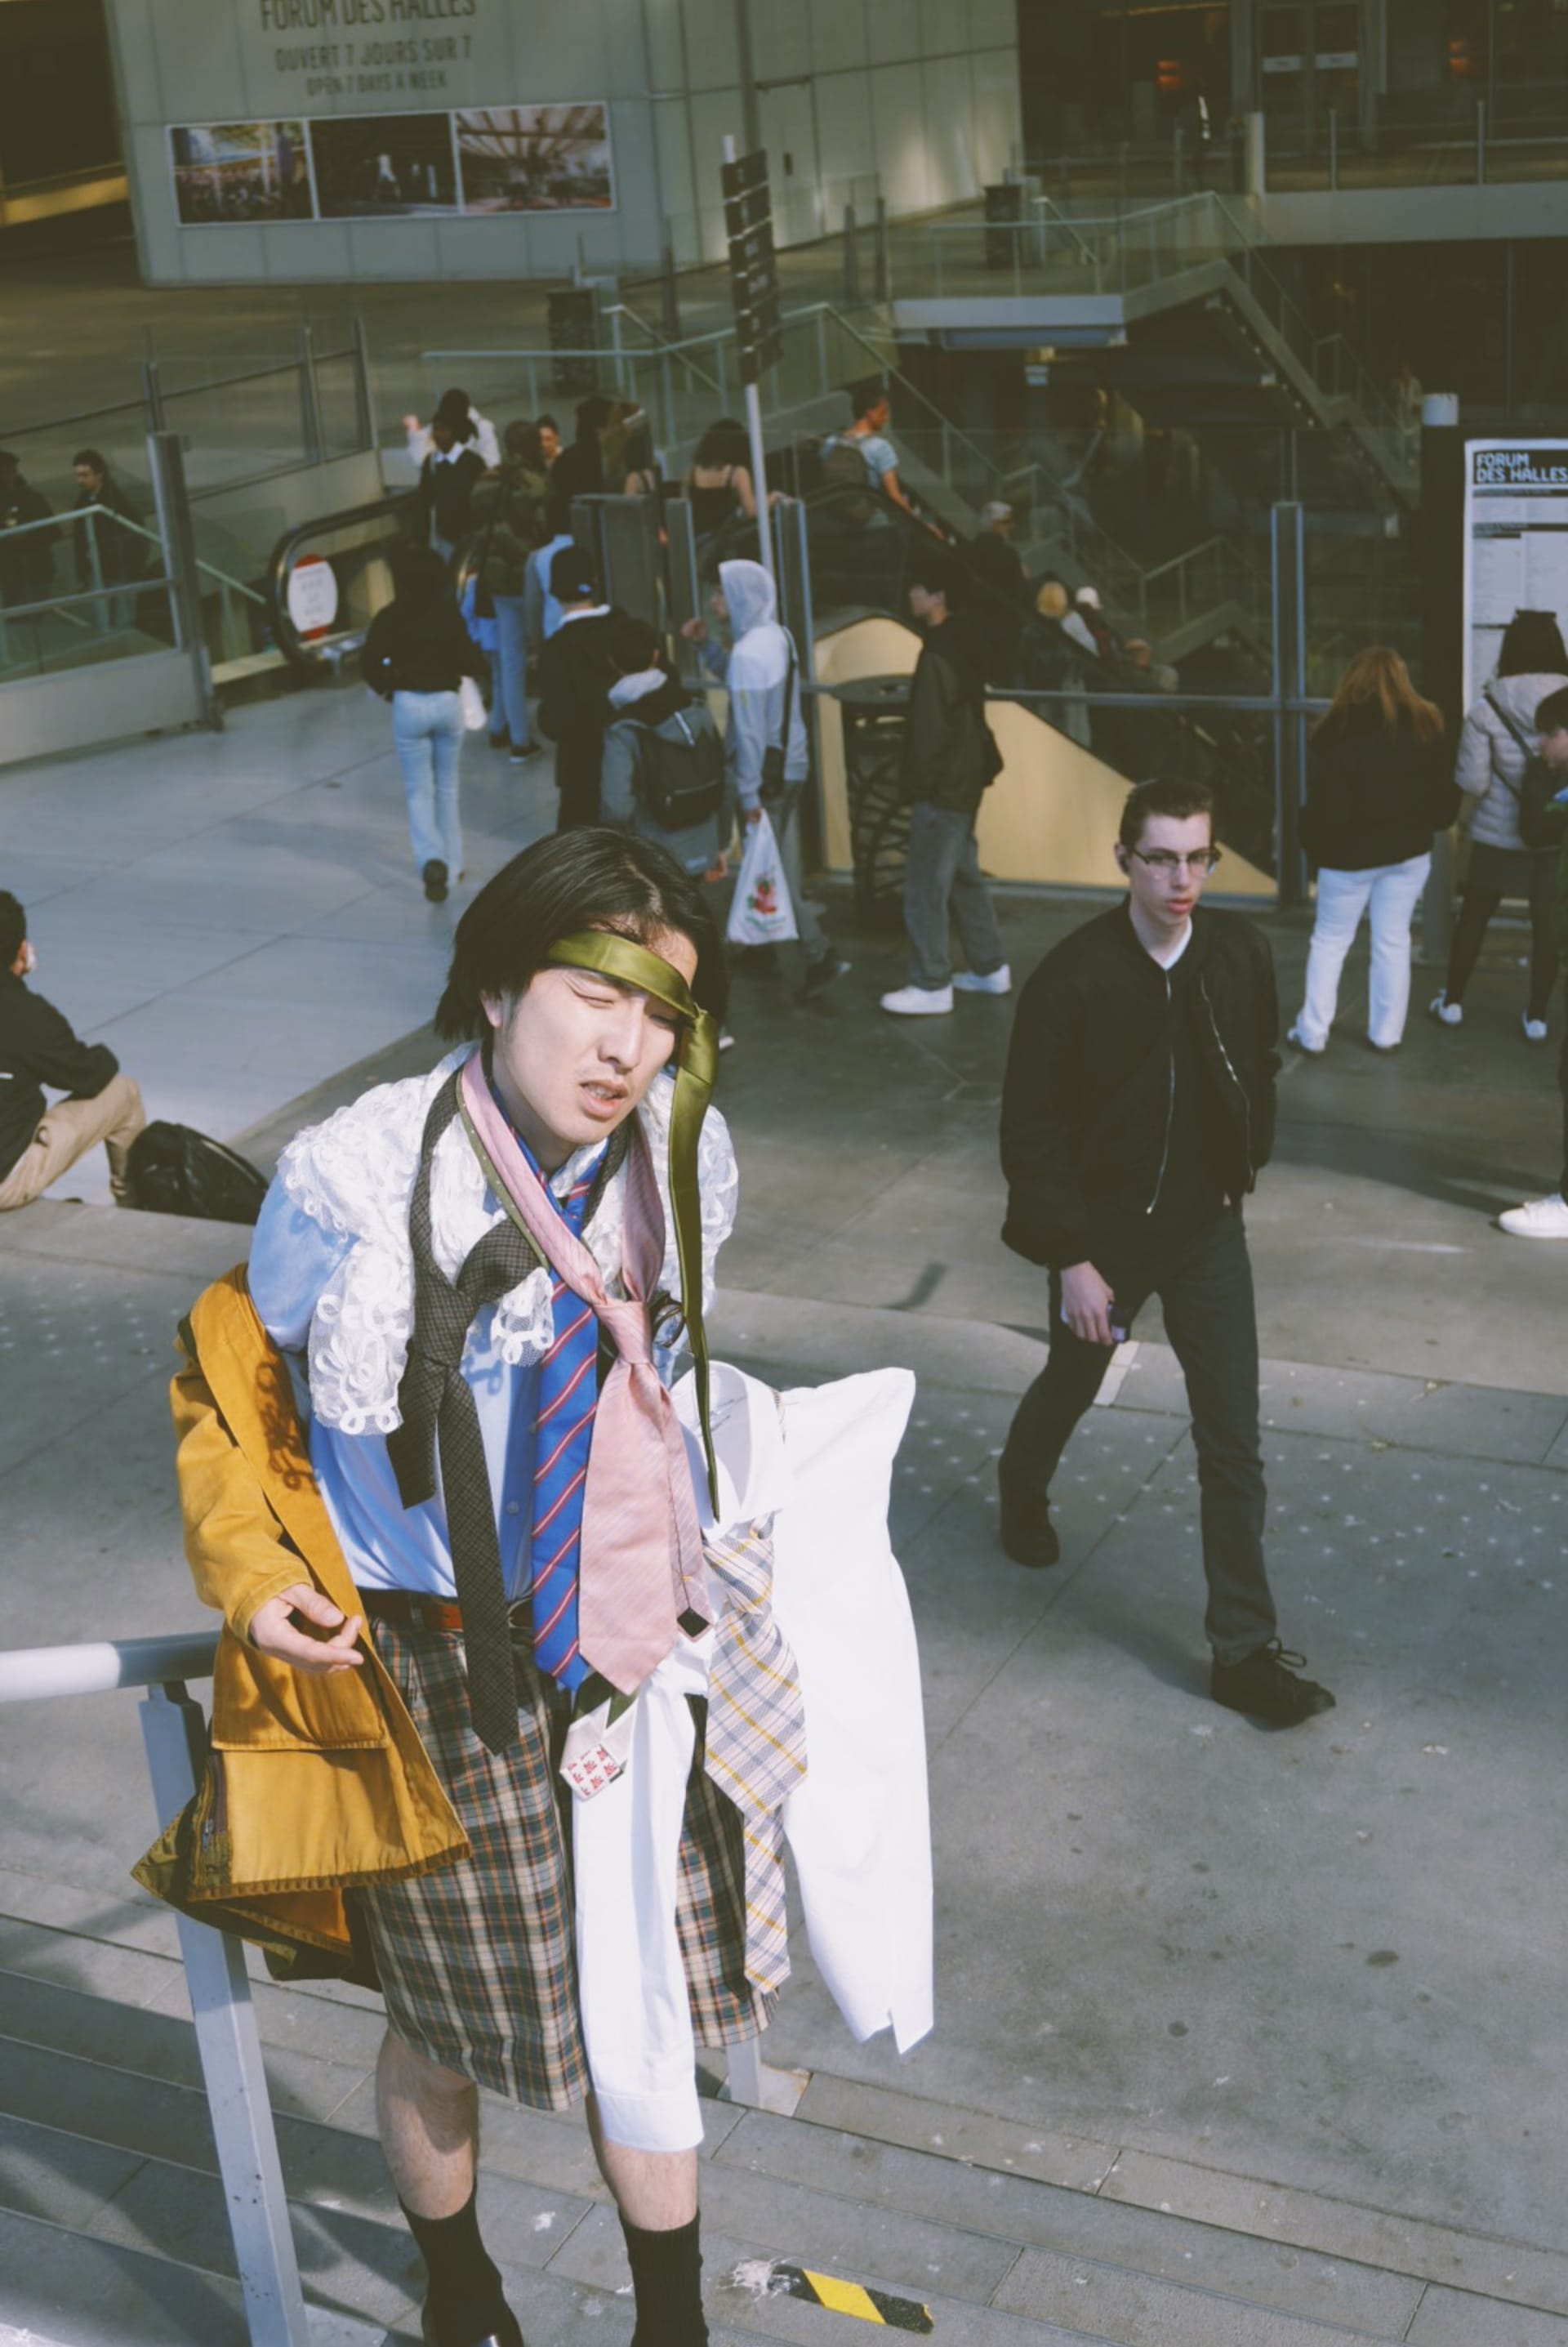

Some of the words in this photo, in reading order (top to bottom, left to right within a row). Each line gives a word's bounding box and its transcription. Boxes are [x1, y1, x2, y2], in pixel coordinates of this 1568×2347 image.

[260, 0, 337, 31] FORUM
[343, 0, 385, 25] DES
[275, 44, 339, 72] OUVERT
[345, 42, 354, 67] 7
[361, 39, 418, 66] JOURS
[423, 36, 457, 62] SUR
[461, 34, 472, 59] 7
[305, 75, 343, 96] OPEN
[358, 73, 392, 93] DAYS
[396, 72, 406, 91] A
[408, 70, 448, 91] WEEK
[1477, 453, 1530, 468] FORUM
[1477, 468, 1506, 484] DES
[1511, 466, 1568, 484] HALLES
